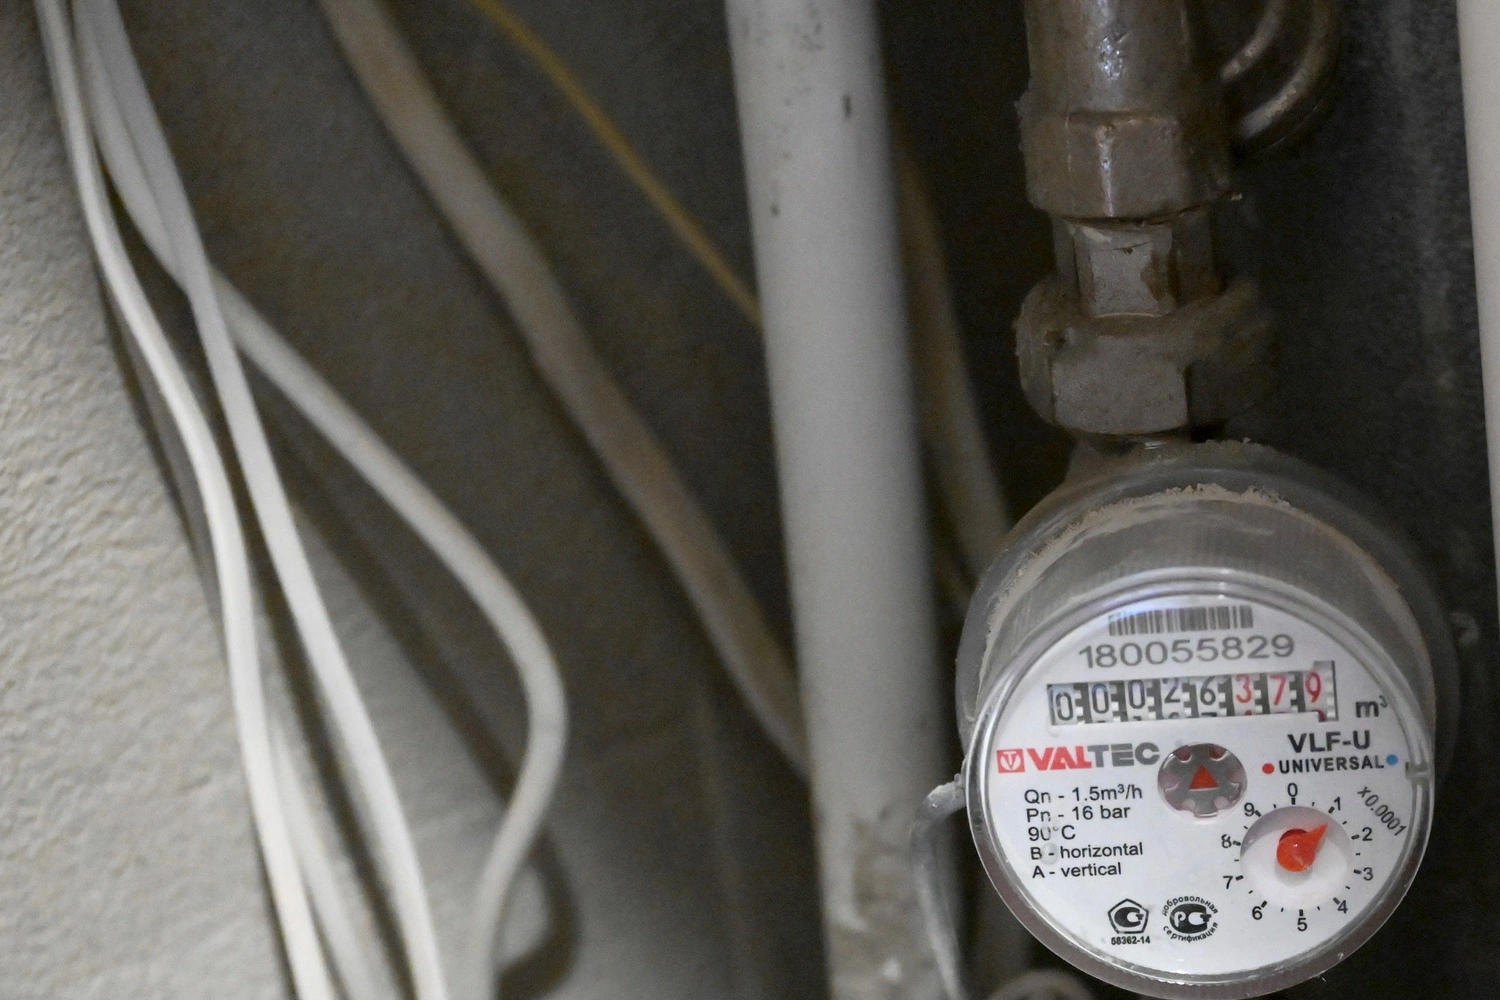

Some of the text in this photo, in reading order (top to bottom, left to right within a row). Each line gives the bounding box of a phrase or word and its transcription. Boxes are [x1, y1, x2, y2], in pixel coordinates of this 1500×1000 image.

[1078, 634, 1295, 669] 180055829
[1288, 730, 1370, 753] VLF-U
[1026, 742, 1160, 771] VALTEC
[1279, 755, 1385, 774] UNIVERSAL
[1024, 788, 1051, 804] Qn
[1287, 782, 1298, 797] 0
[1244, 803, 1255, 817] 9
[1334, 797, 1342, 811] 1
[1026, 808, 1051, 822] Pn
[1072, 806, 1094, 820] 16
[1100, 804, 1131, 819] bar
[1221, 834, 1232, 848] 8
[1362, 827, 1373, 841] 2
[1030, 846, 1043, 860] B
[1060, 842, 1143, 859] horizontal
[1032, 865, 1045, 878] A
[1061, 862, 1122, 877] vertical
[1363, 867, 1374, 881] 3
[1222, 875, 1233, 889] 7
[1252, 905, 1263, 920] 6
[1337, 900, 1348, 914] 4
[1163, 921, 1219, 943] сертификация
[1297, 917, 1307, 932] 5
[1111, 936, 1151, 945] 58362-14
